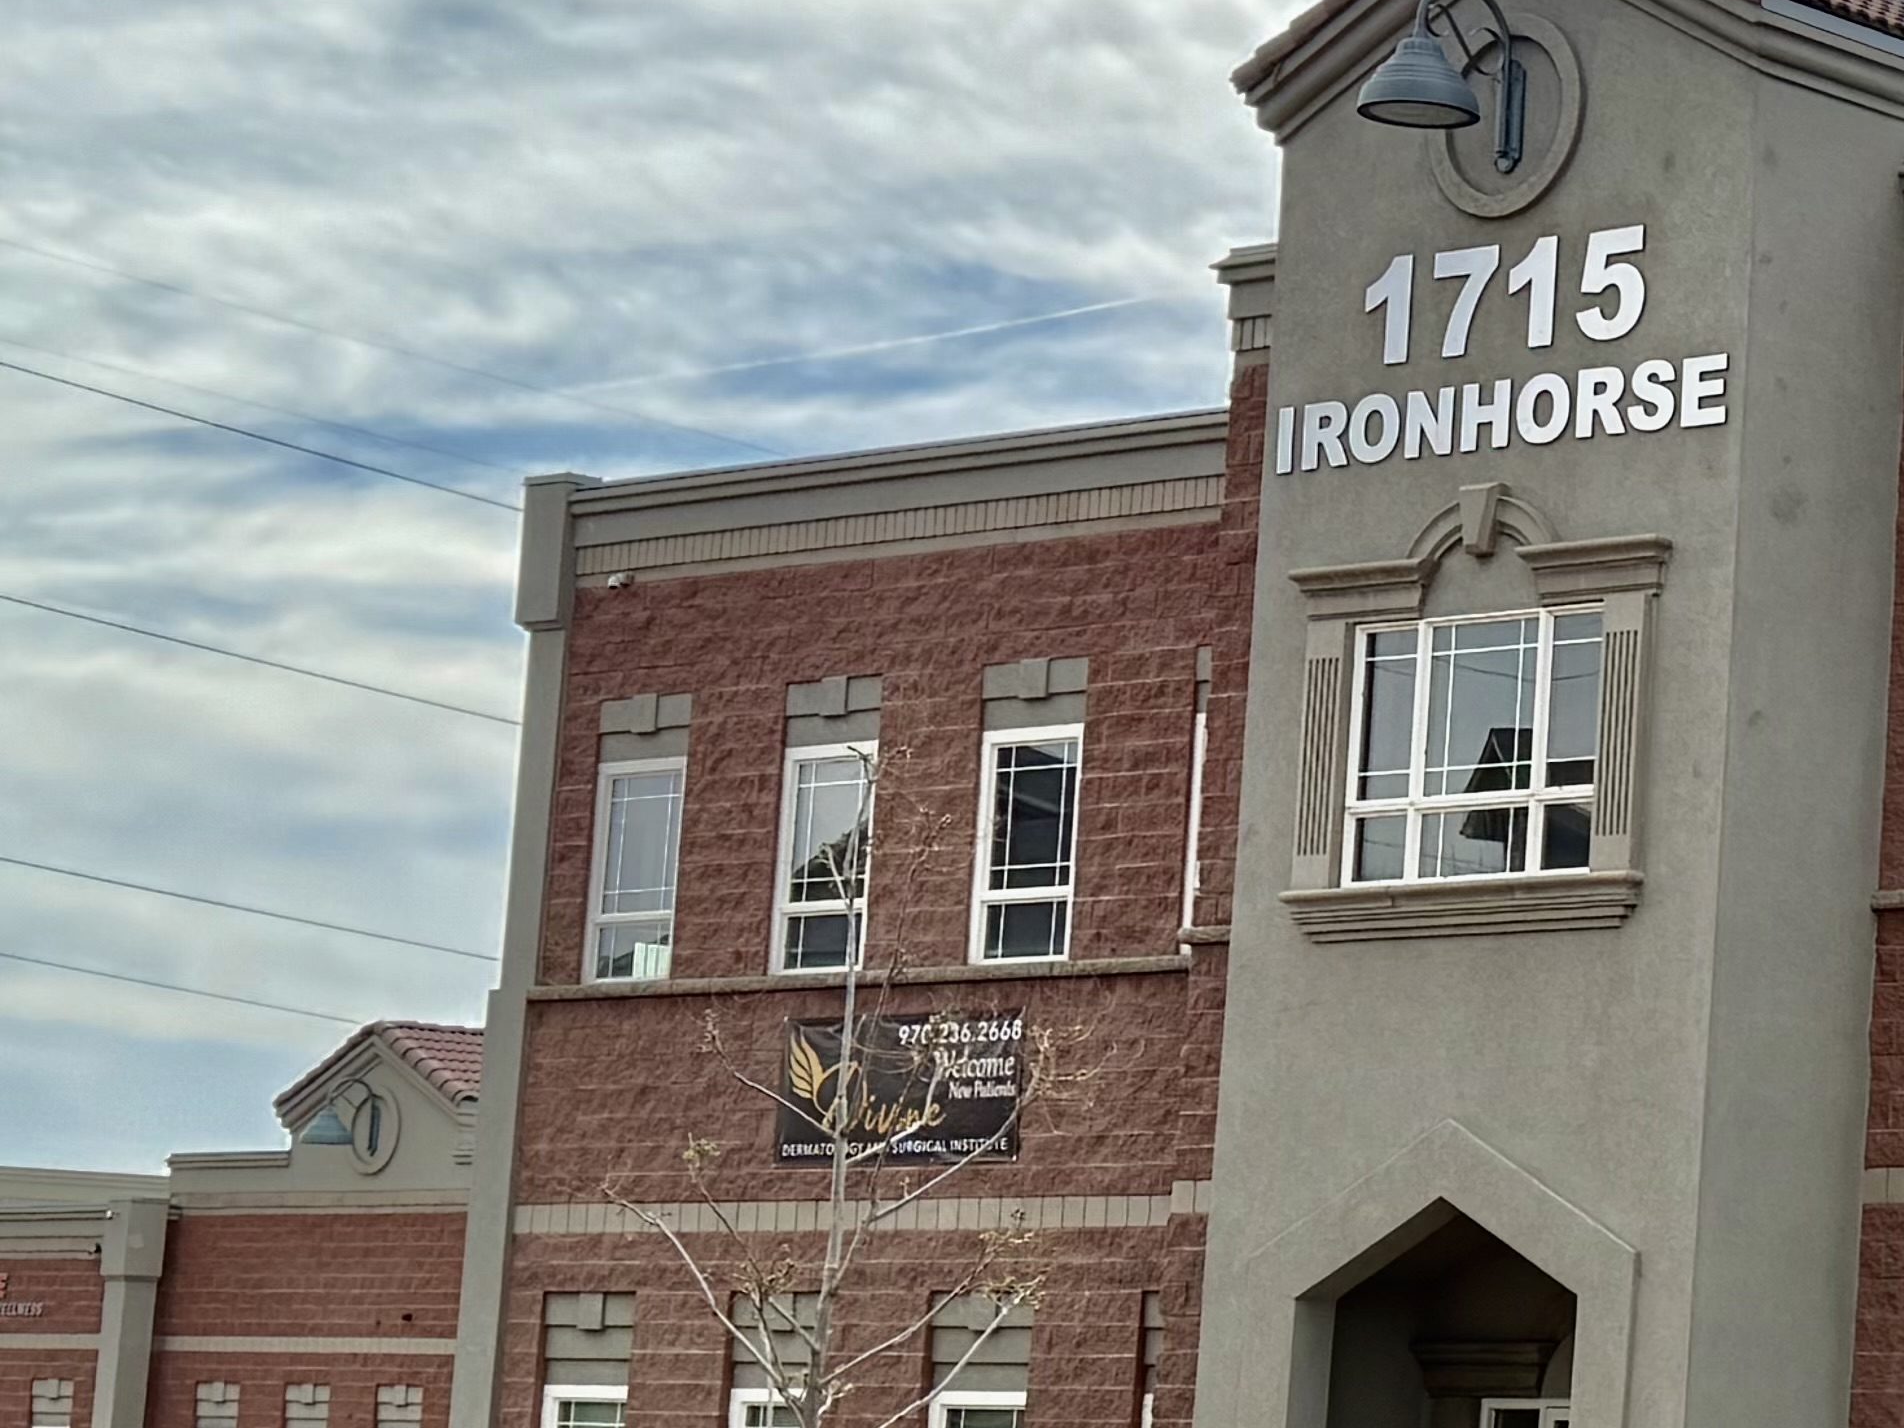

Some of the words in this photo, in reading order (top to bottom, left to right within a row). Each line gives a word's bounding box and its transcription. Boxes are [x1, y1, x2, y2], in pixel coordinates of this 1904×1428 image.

[1364, 223, 1646, 366] 1715
[1275, 352, 1728, 476] IRONHORSE
[933, 1048, 1015, 1078] Welcome
[949, 1082, 972, 1099] New
[974, 1080, 1016, 1098] Patients
[782, 1142, 863, 1157] DERMATOGY
[866, 1141, 890, 1155] AN
[892, 1140, 946, 1155] SURGICAL
[0, 1302, 43, 1317] ELLNESS
